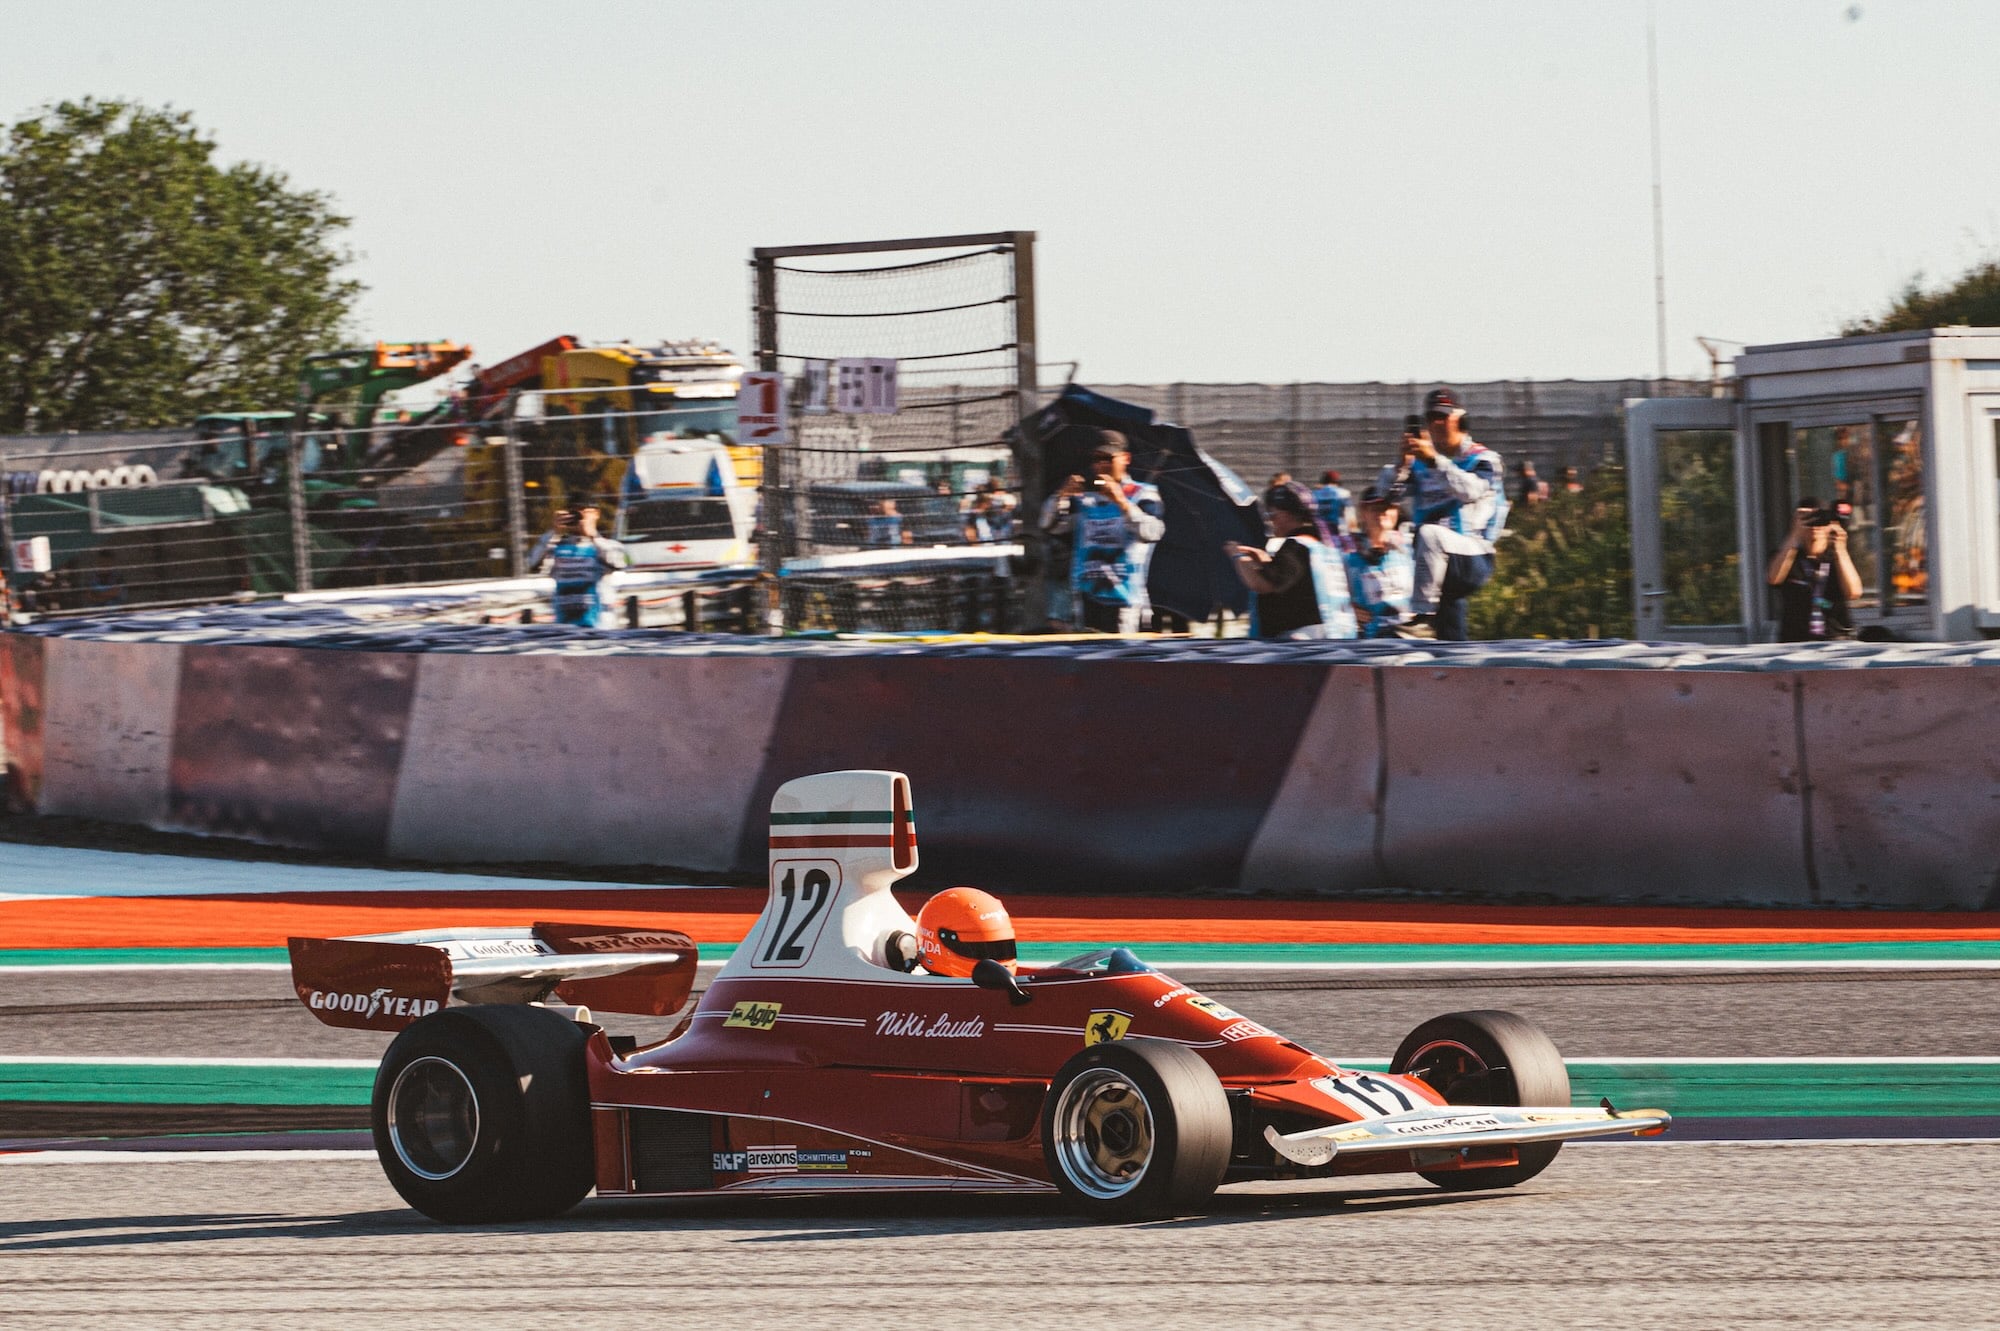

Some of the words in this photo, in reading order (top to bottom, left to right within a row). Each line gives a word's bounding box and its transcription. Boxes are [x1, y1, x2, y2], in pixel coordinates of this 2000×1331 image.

[763, 868, 831, 962] 12
[742, 1003, 778, 1027] Agip
[876, 1011, 926, 1037] Niki
[924, 1012, 985, 1038] Lauda
[713, 1152, 746, 1171] SKF
[748, 1151, 797, 1166] arexons
[798, 1153, 847, 1162] SCHMITTHELM
